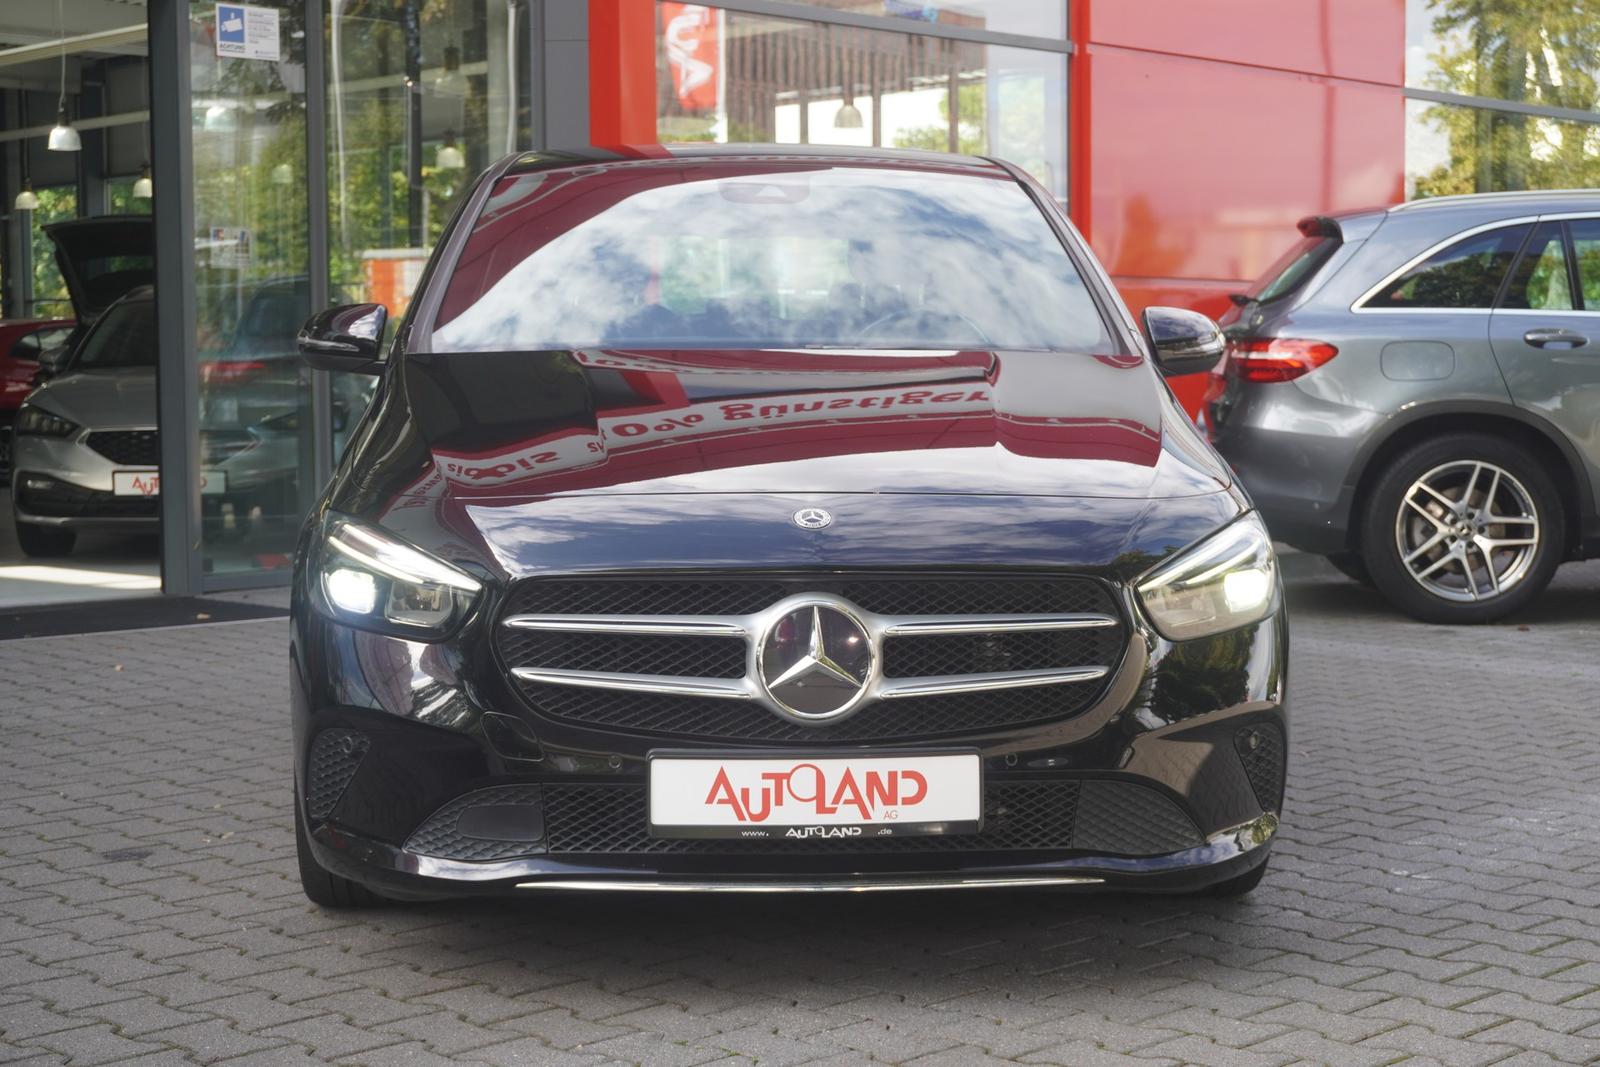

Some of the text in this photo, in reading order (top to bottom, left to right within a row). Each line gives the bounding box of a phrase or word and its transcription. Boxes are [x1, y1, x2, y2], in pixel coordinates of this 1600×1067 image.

[705, 763, 928, 822] AUTOLAND AG
[785, 826, 862, 839] AUTOLAND
